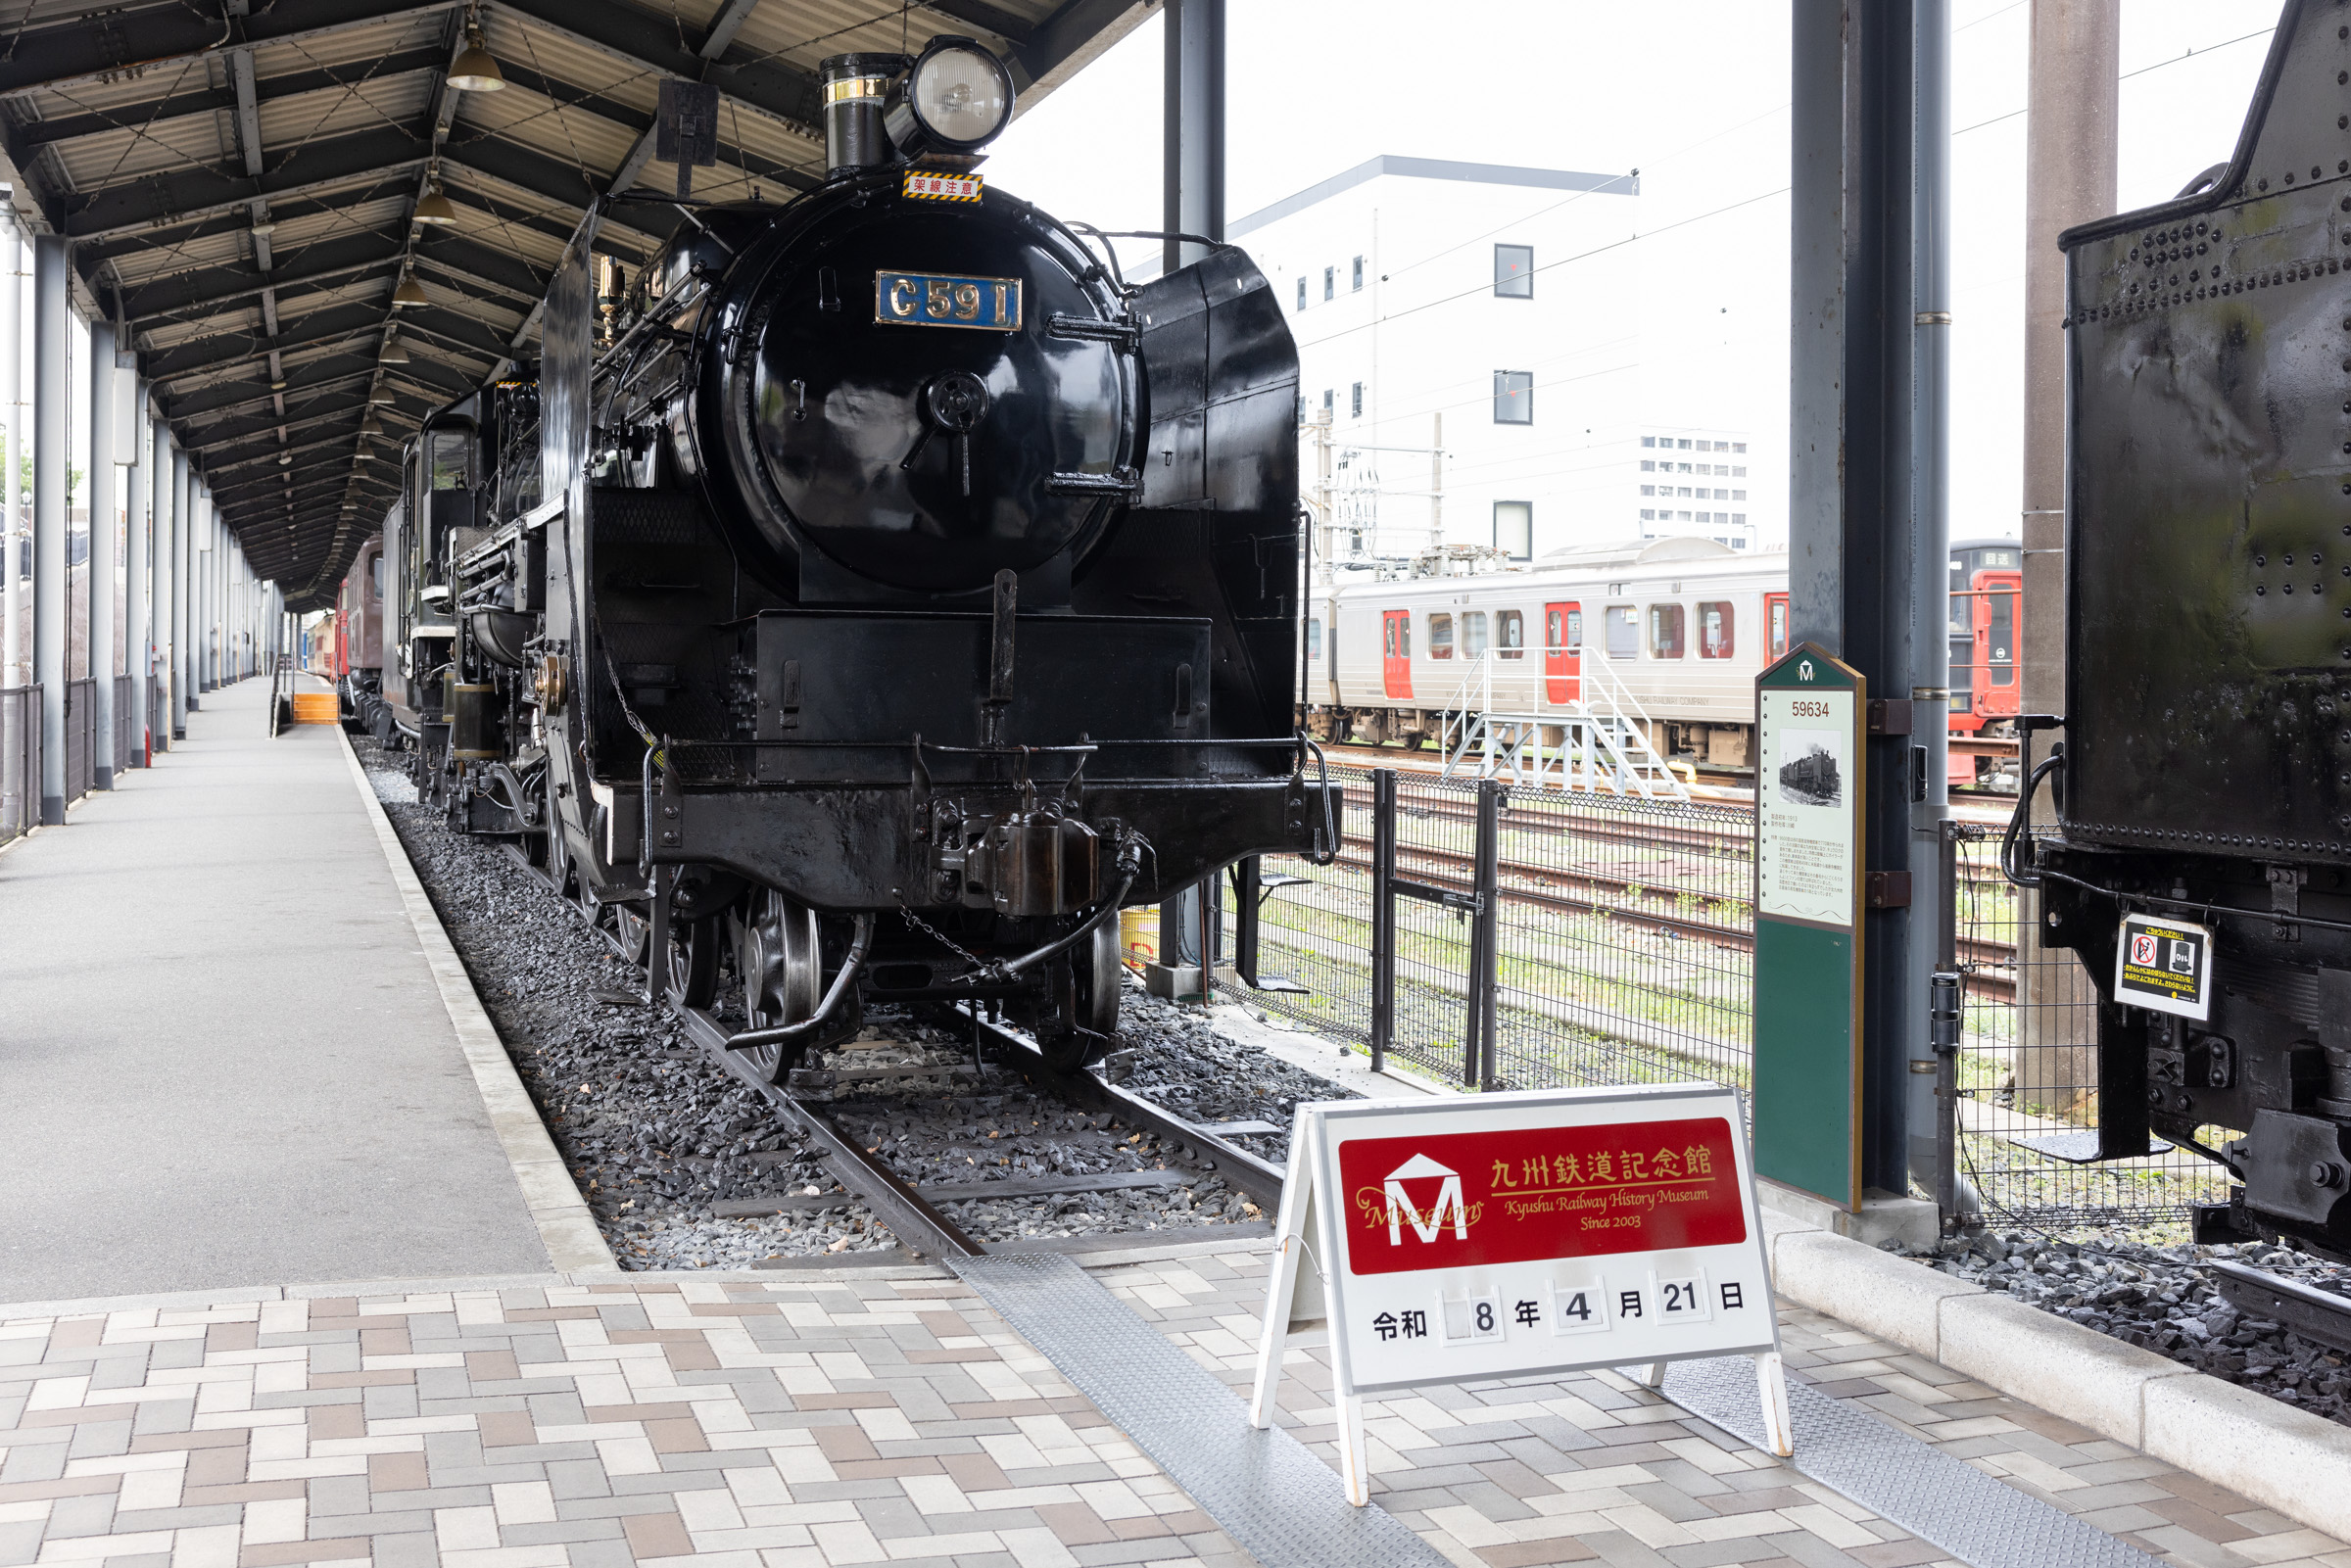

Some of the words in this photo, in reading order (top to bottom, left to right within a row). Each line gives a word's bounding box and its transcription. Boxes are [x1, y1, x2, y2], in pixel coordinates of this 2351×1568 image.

[914, 178, 973, 196] 架線注意
[1986, 552, 2009, 565] 回送
[1654, 696, 1678, 705] RAILWAY
[1680, 697, 1709, 706] COMPANY
[1792, 700, 1830, 718] 59634
[2176, 953, 2188, 962] OIL
[1490, 1144, 1713, 1189] 九州鉄道記念館
[1356, 1185, 1485, 1230] Museum
[1504, 1192, 1555, 1221] Kyushu
[1557, 1189, 1608, 1215] Railway
[1610, 1188, 1656, 1212] History
[1657, 1186, 1709, 1205] Museum
[1580, 1215, 1611, 1231] Since
[1612, 1215, 1642, 1229] 2003
[1372, 1309, 1428, 1341] 令和
[1476, 1301, 1495, 1332] 8
[1514, 1300, 1541, 1328] 年
[1565, 1293, 1592, 1321] 4
[1619, 1290, 1643, 1319] 月
[1662, 1282, 1698, 1311] 21
[1720, 1281, 1744, 1310] 日
